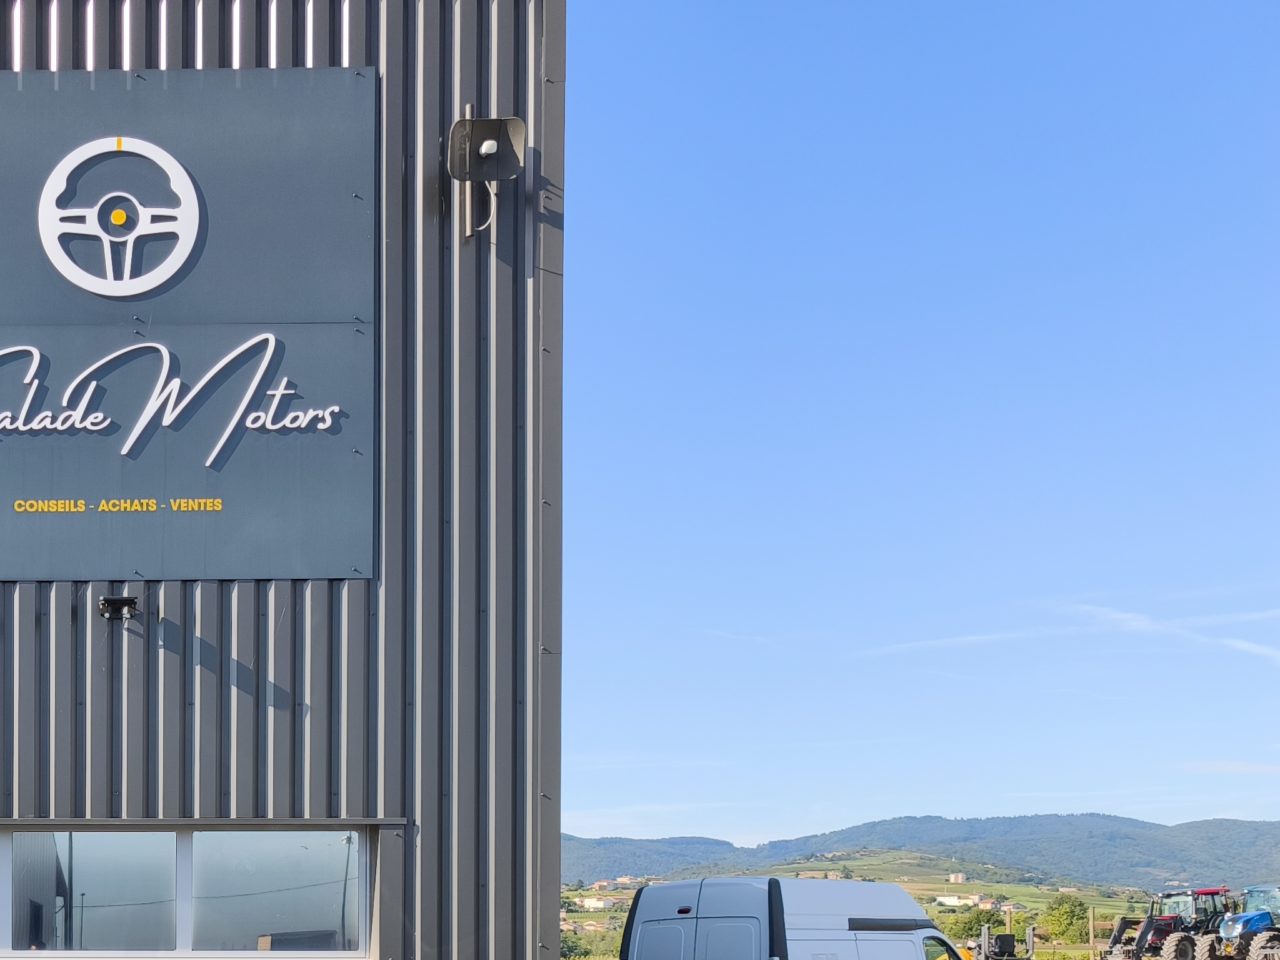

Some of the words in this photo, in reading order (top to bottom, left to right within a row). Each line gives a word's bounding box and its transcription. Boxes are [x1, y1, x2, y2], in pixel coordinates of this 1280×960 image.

[63, 333, 340, 467] Motors
[14, 500, 86, 512] CONSEILS
[98, 499, 157, 512] ACHATS
[170, 498, 222, 511] VENTES
